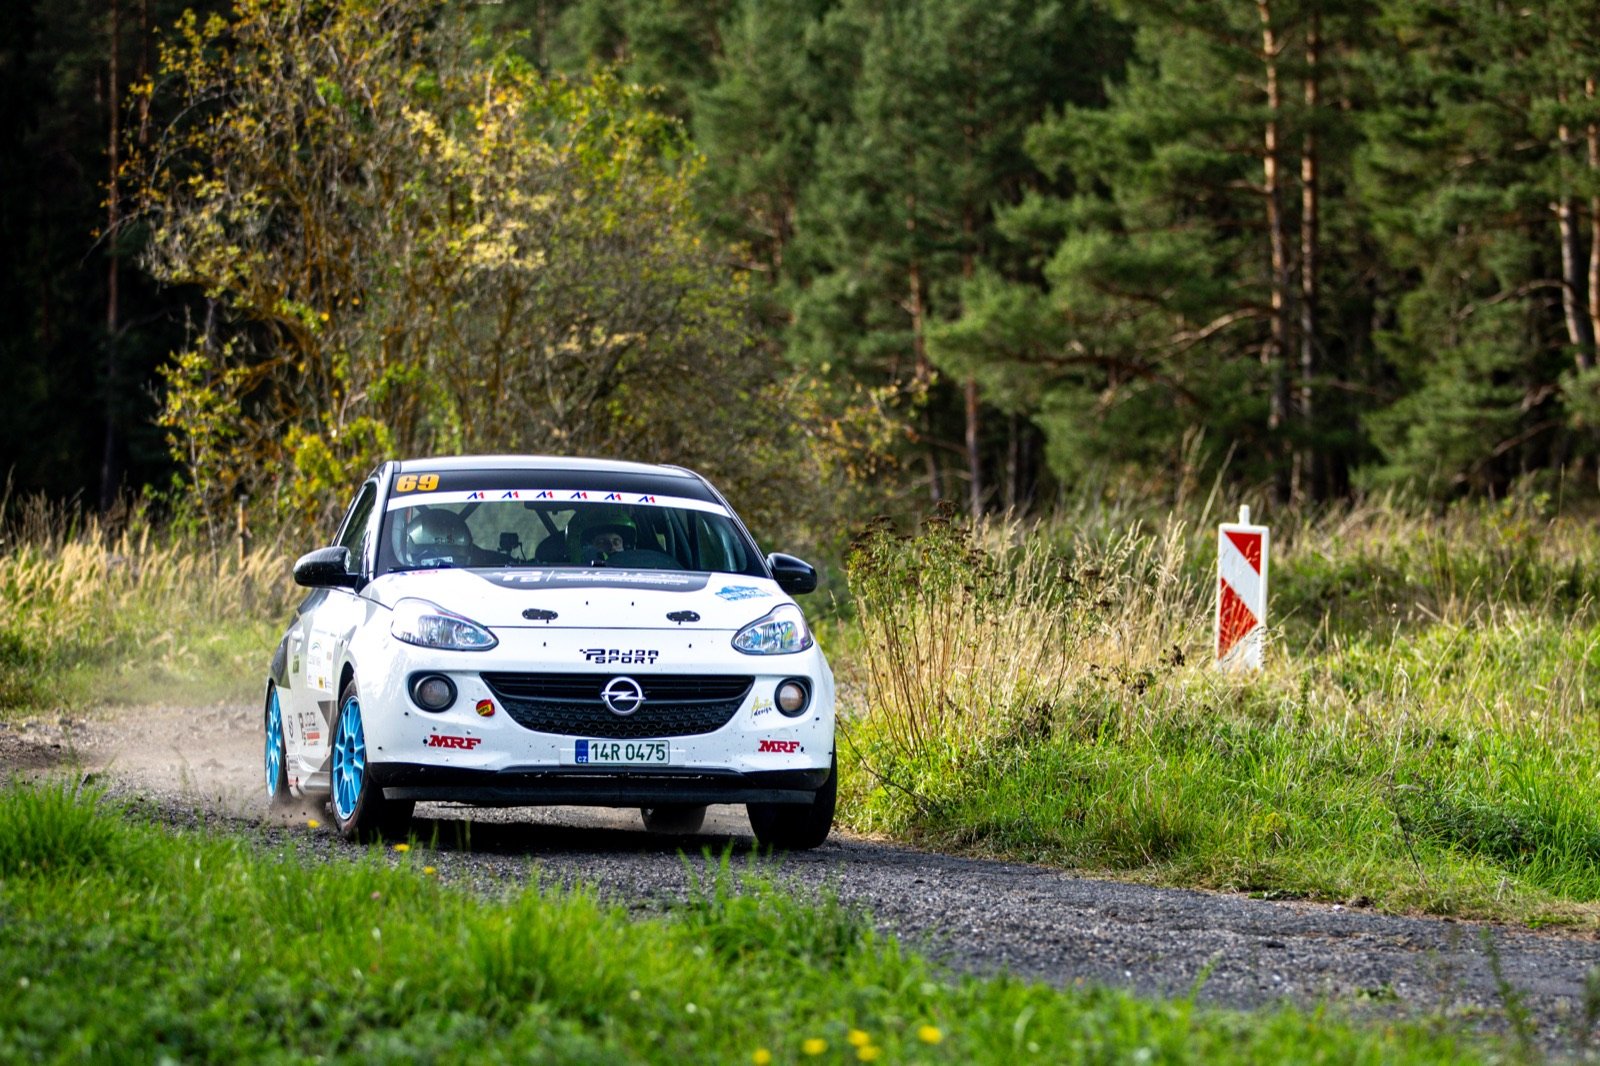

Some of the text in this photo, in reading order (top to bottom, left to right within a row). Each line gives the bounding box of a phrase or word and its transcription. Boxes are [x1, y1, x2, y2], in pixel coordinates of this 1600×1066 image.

[396, 474, 440, 493] 69
[595, 656, 657, 664] SPORT
[428, 734, 482, 750] MRF
[757, 740, 800, 754] MRF
[577, 743, 666, 763] CZ 14R 0475
